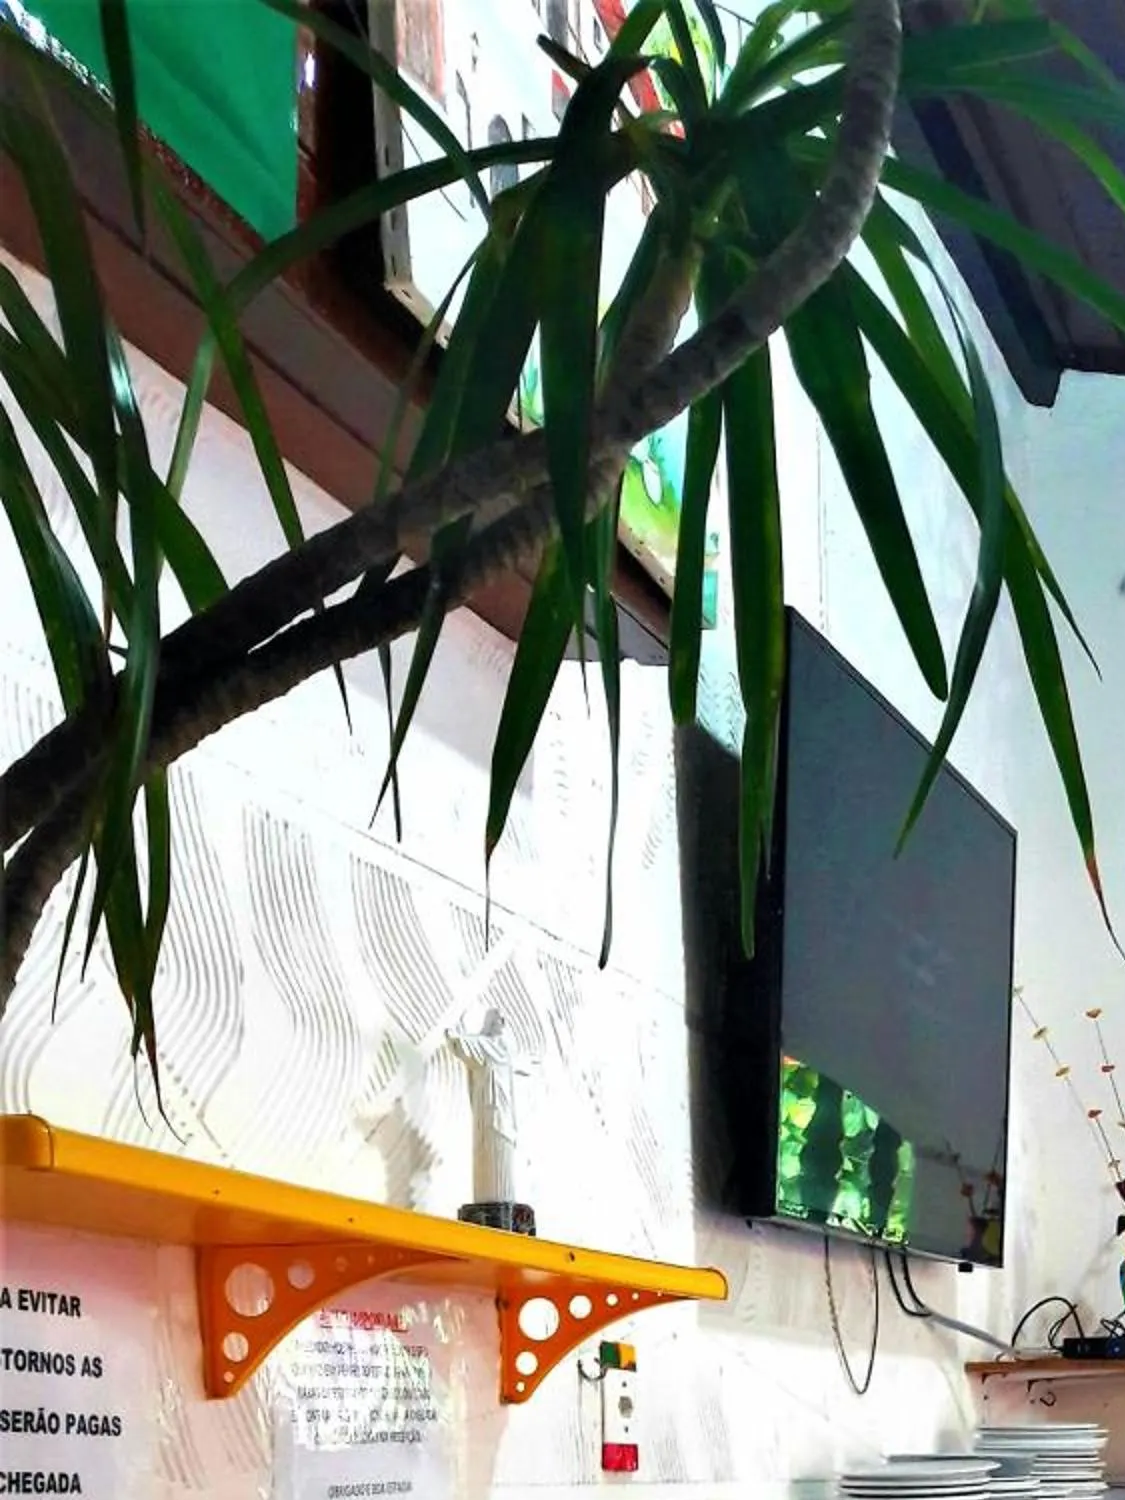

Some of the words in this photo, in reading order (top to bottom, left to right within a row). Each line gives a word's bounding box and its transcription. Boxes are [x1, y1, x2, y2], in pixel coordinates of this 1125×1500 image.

[18, 1289, 82, 1318] EVITAR
[0, 1348, 75, 1377] TORNOS
[81, 1355, 103, 1379] AS
[0, 1407, 60, 1435] SERÃO
[65, 1413, 122, 1437] PAGAS
[0, 1471, 82, 1494] CHEGADA
